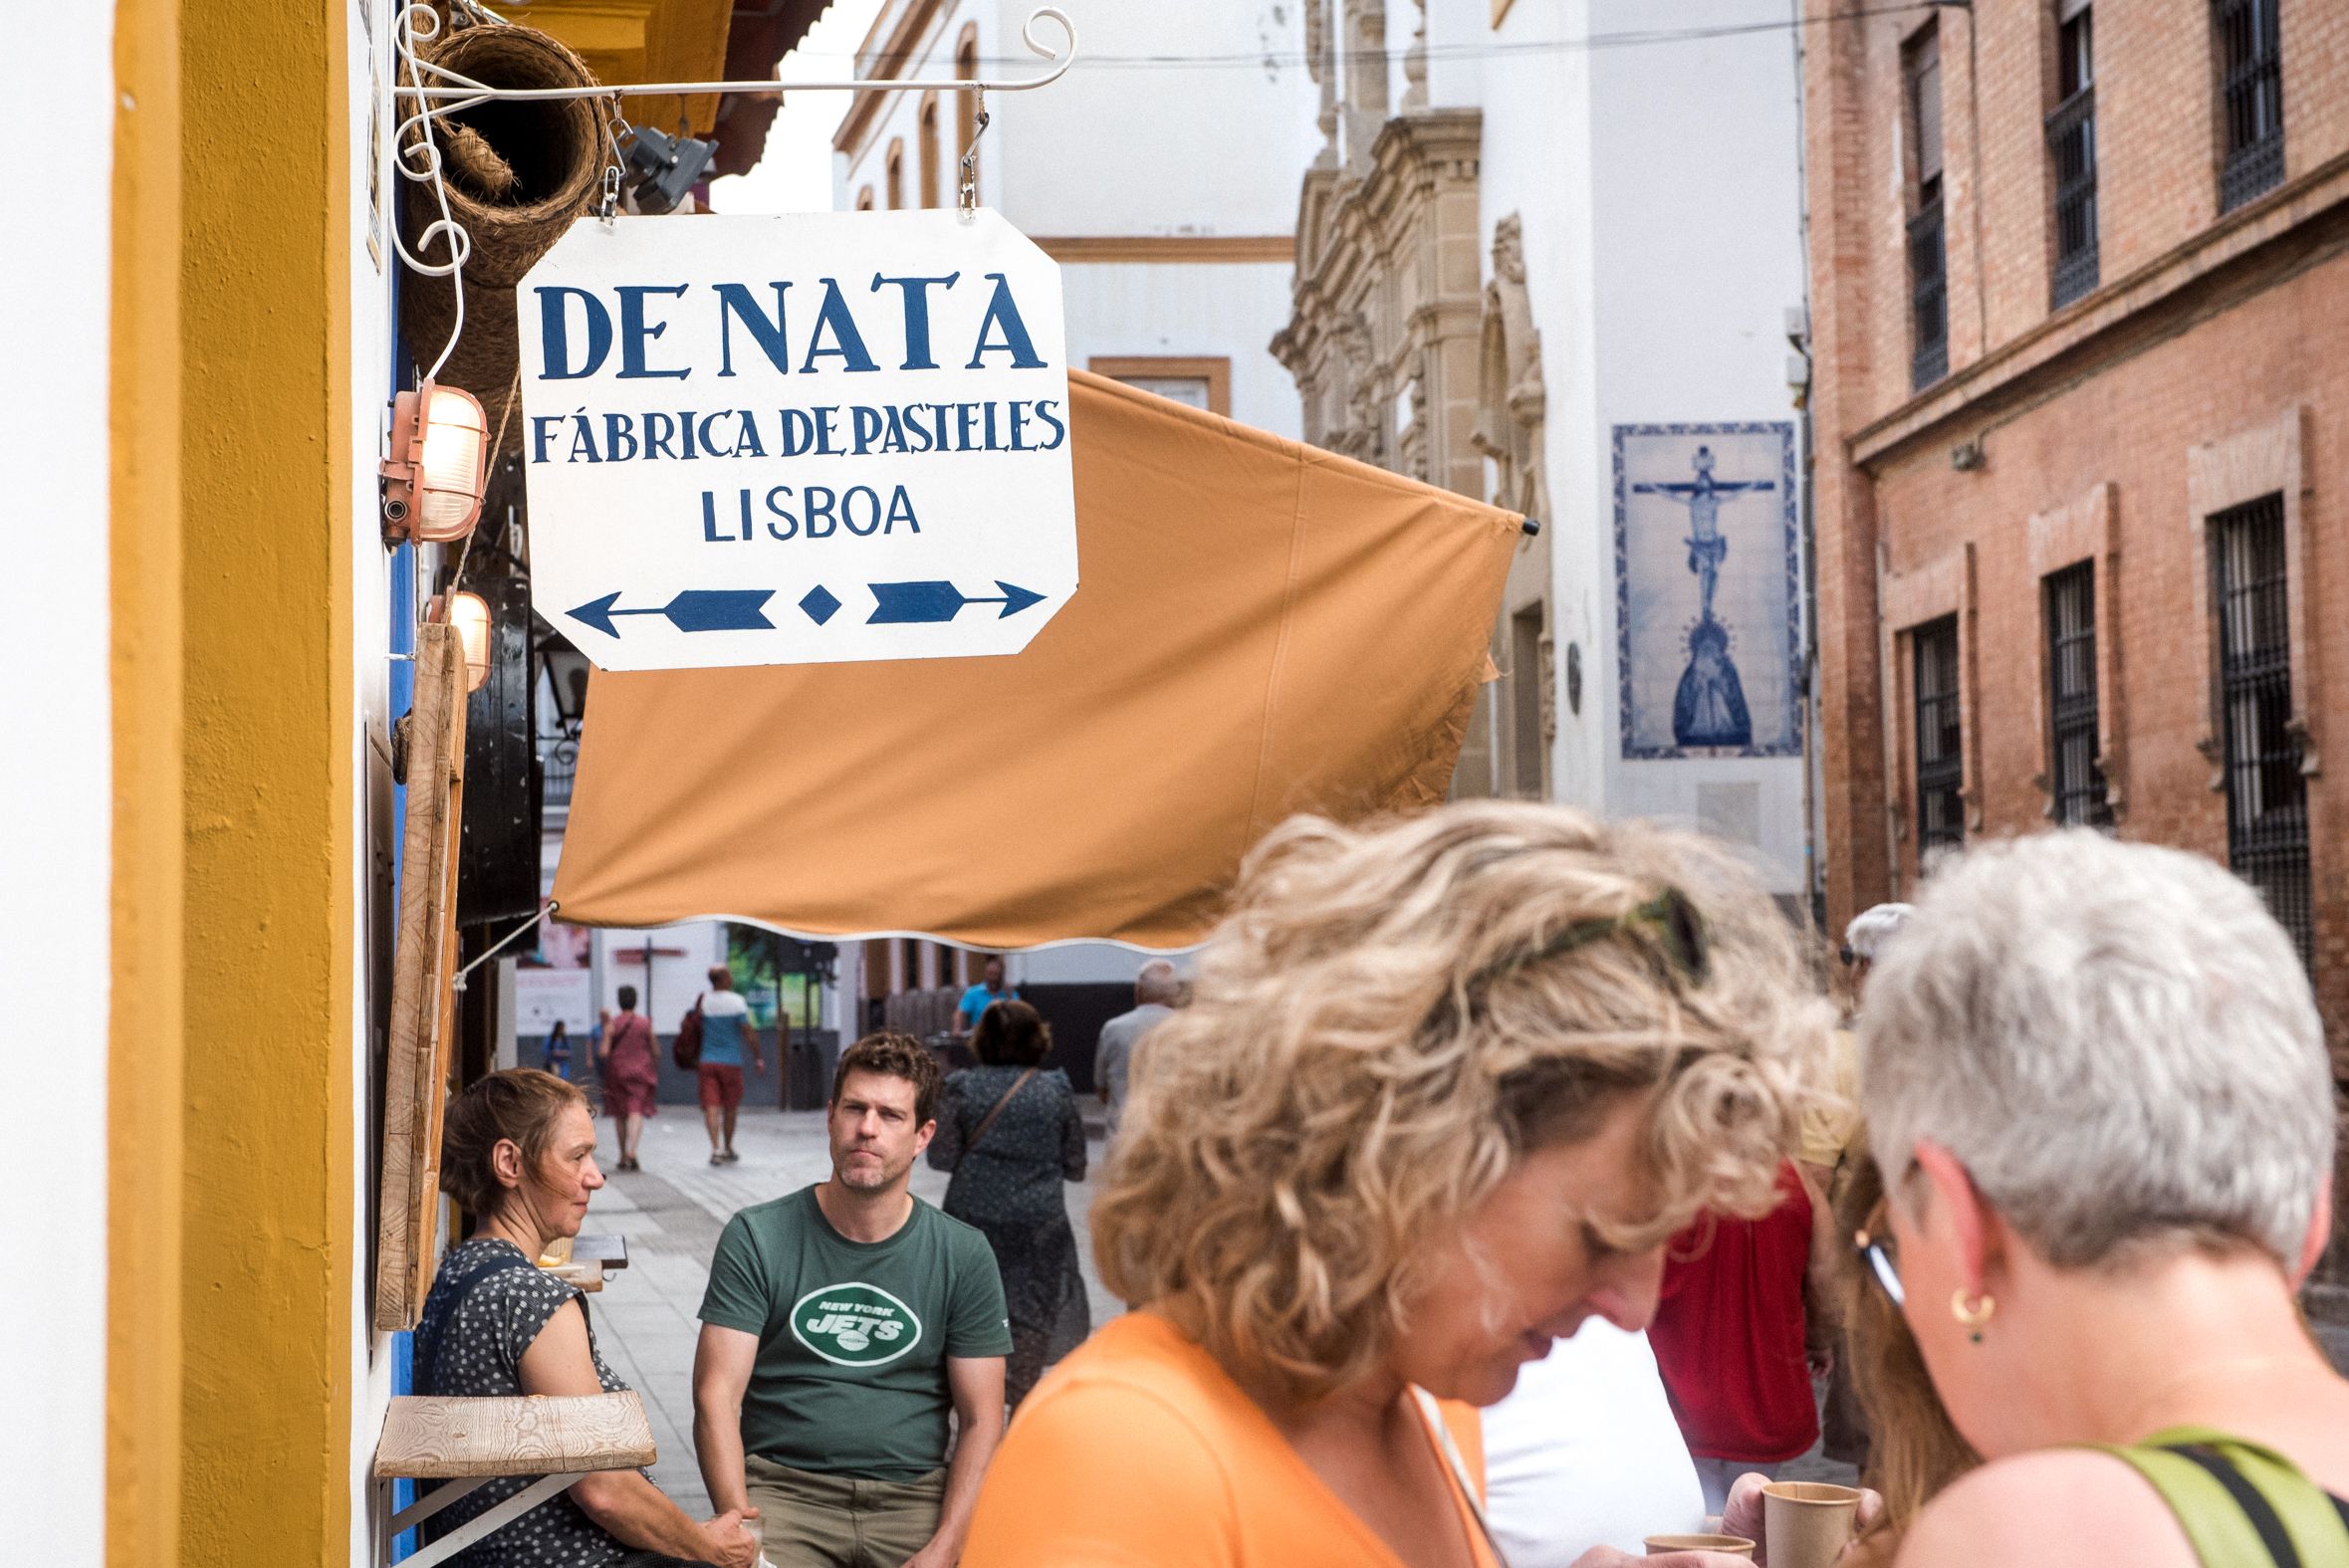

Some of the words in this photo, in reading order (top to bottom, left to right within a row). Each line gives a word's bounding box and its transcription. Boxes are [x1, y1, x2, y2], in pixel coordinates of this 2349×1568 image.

[533, 282, 692, 380] DE
[711, 271, 1049, 377] NATA
[531, 406, 769, 463] FÁBRICA
[780, 406, 848, 457] DE
[850, 400, 1065, 456] PASTELES
[701, 485, 921, 543] LISBOA
[806, 1313, 904, 1341] JETS
[819, 1300, 854, 1312] NEW
[853, 1302, 895, 1316] YORK
